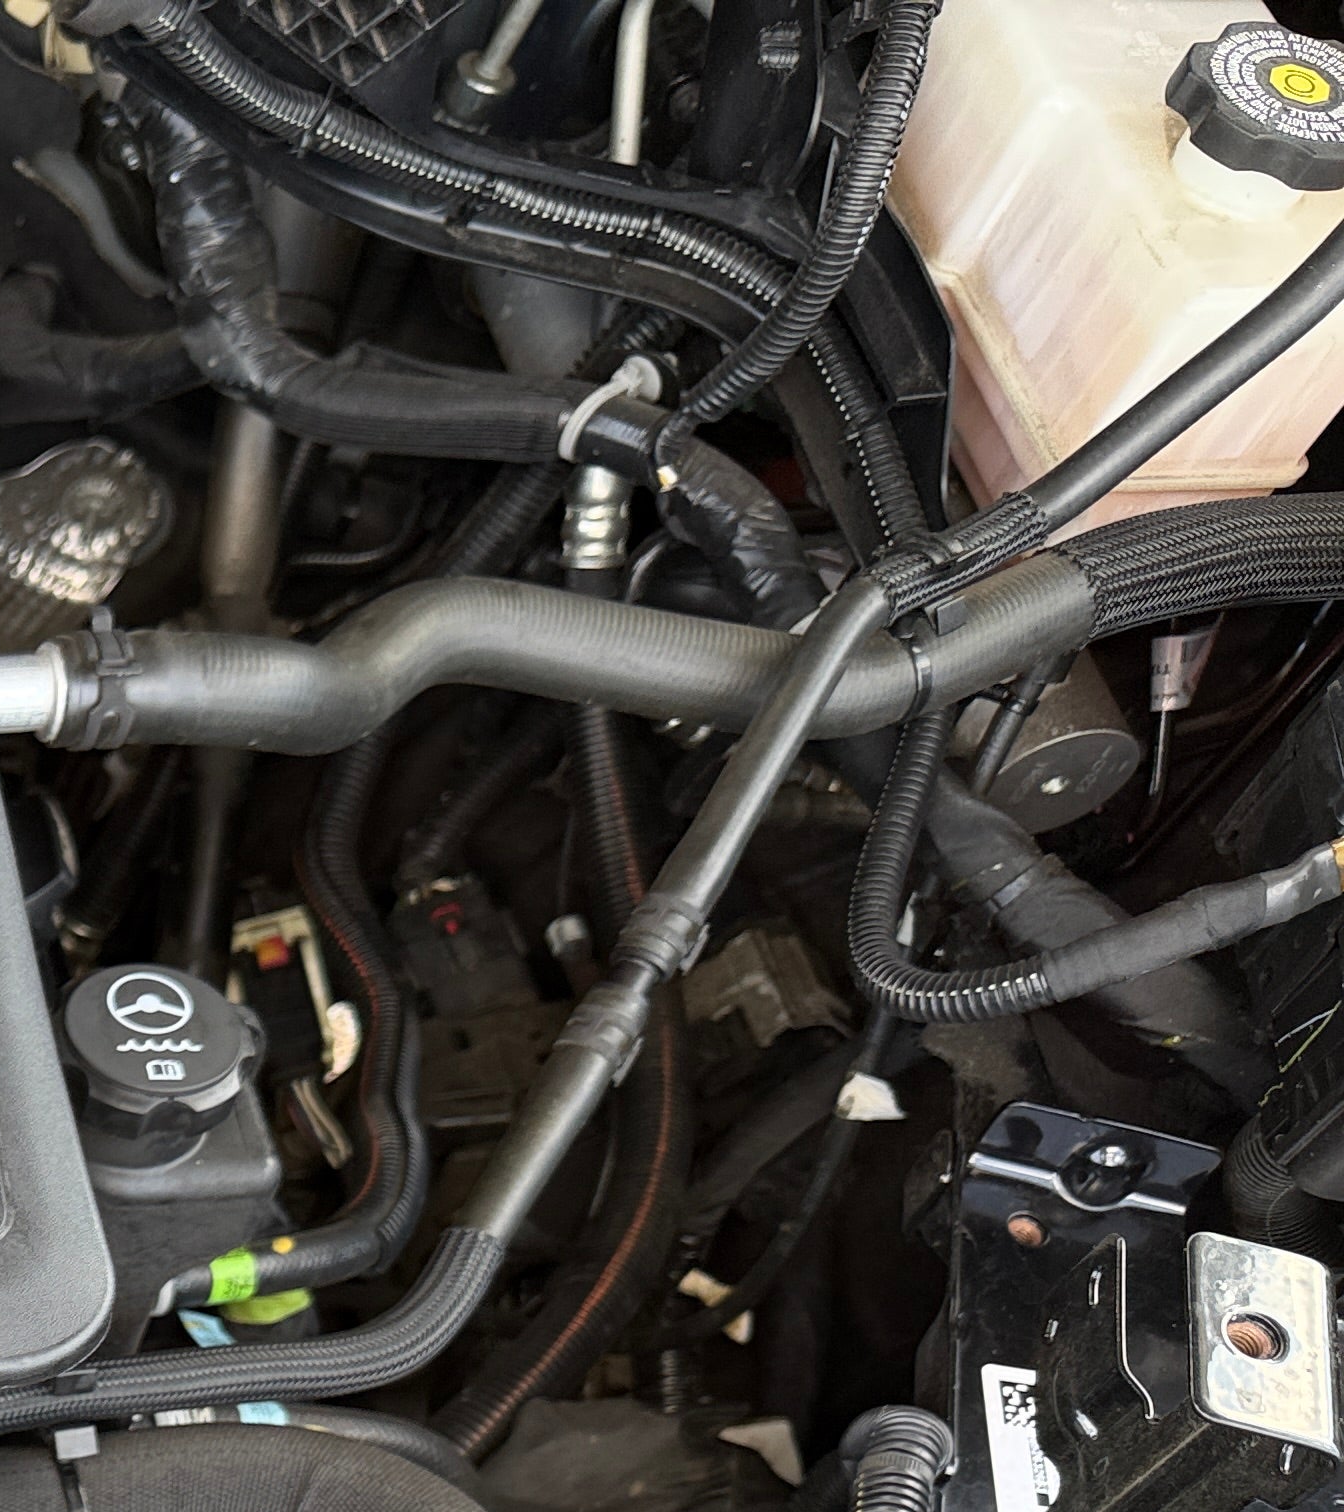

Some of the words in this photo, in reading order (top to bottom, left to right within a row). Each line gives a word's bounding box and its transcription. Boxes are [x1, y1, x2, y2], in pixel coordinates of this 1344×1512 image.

[1270, 40, 1289, 49] CAP
[1236, 86, 1256, 101] USE
[1248, 85, 1282, 110] FILLER
[1250, 100, 1279, 118] ONLY
[1318, 132, 1337, 142] LA
